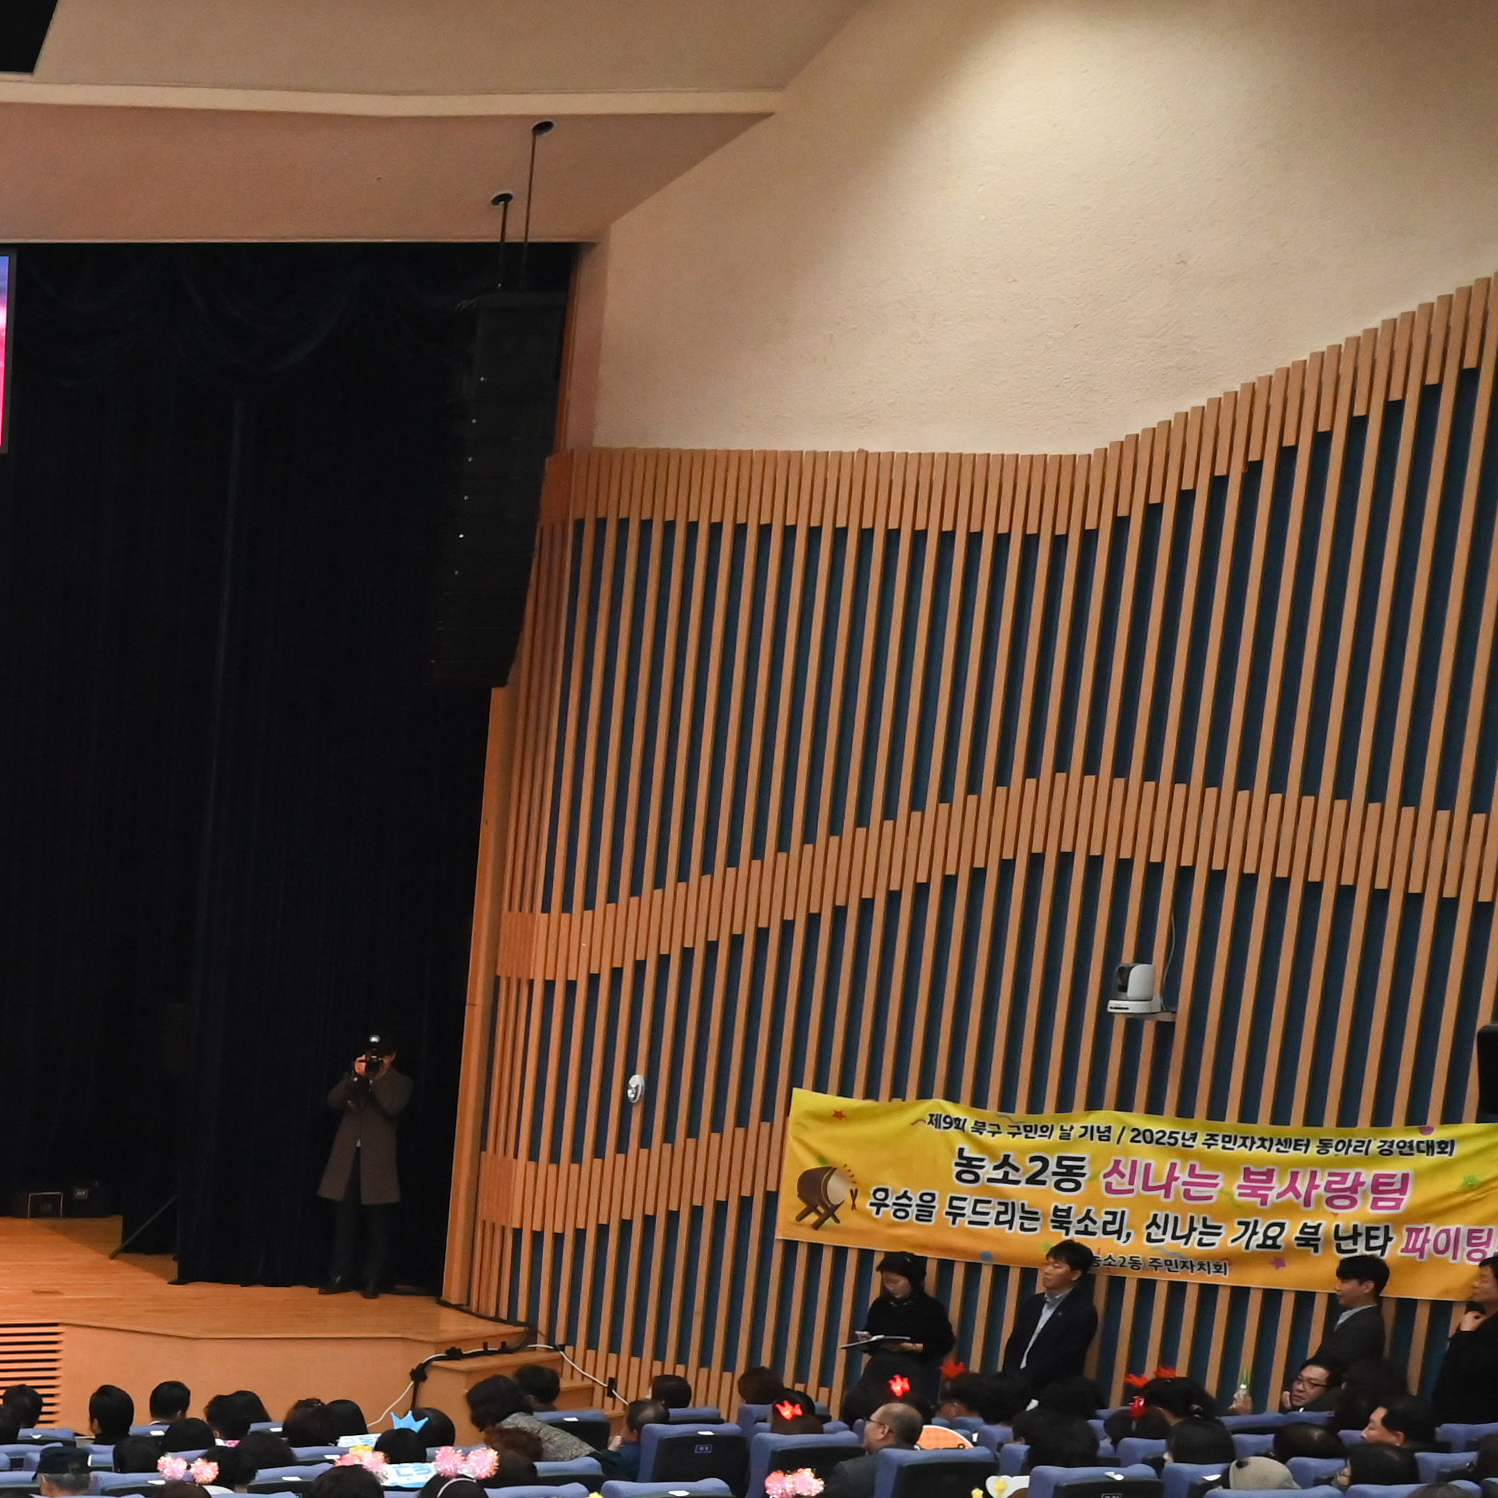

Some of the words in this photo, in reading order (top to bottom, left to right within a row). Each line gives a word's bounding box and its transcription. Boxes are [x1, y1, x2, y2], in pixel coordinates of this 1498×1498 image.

[926, 1112, 967, 1133] 제9회
[970, 1120, 1003, 1138] 북구
[1006, 1123, 1054, 1140] 구민의
[1058, 1123, 1075, 1141] 날
[1078, 1124, 1112, 1143] 기념
[1129, 1127, 1198, 1149] 2025년
[1201, 1132, 1311, 1155] 주민자치센터
[1315, 1137, 1373, 1156] 동아리
[1376, 1138, 1456, 1157] 경연대회
[953, 1147, 1088, 1193] 농소2동
[1102, 1158, 1221, 1202] 신나는
[1236, 1166, 1411, 1212] 북사랑팀
[868, 1186, 937, 1223] 우승을
[944, 1195, 1041, 1233] 두드리는
[1049, 1204, 1132, 1244] 북소리,
[1144, 1212, 1224, 1247] 신나는
[1230, 1218, 1288, 1251] 가요
[1293, 1221, 1324, 1254] 북
[1333, 1222, 1394, 1257] 난타
[1399, 1226, 1496, 1263] 파이팅
[1148, 1256, 1229, 1276] 주민자치회
